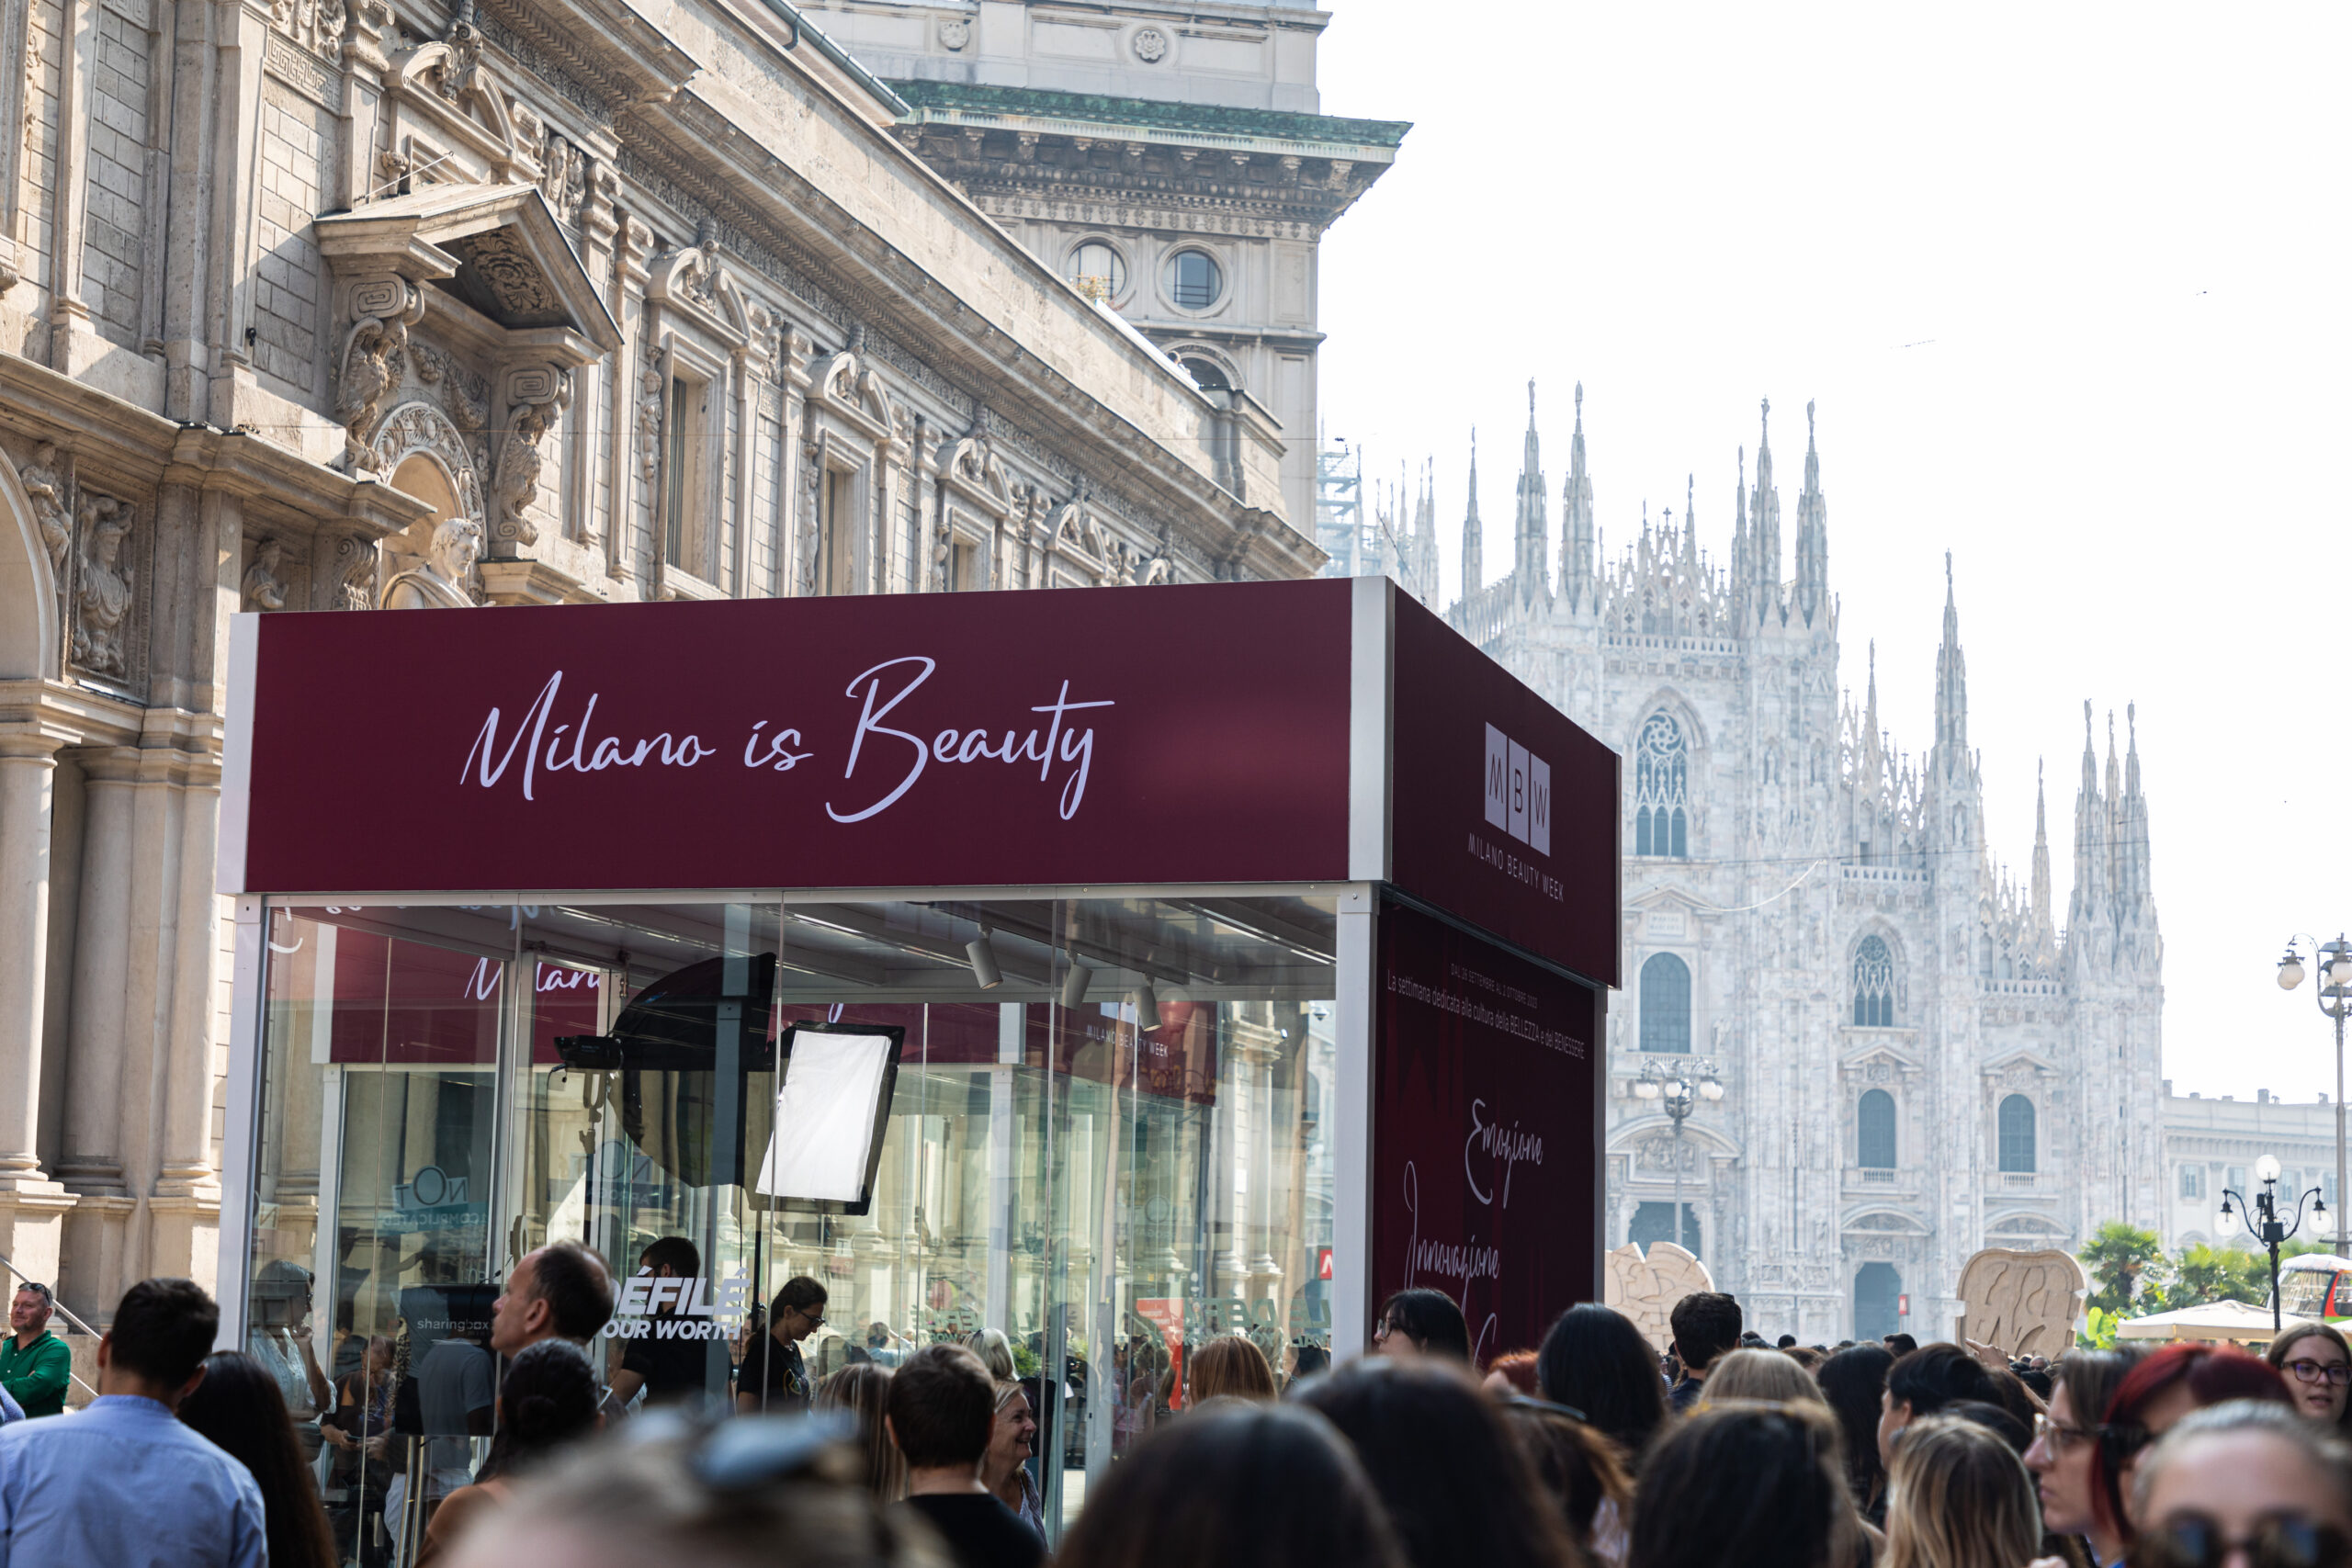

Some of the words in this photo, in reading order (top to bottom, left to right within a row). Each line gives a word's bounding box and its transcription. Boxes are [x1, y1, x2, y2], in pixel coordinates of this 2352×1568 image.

[460, 671, 716, 800] Milano
[745, 721, 813, 771] is
[826, 657, 1114, 823] Beauty
[1468, 831, 1504, 870] MILANO
[1507, 854, 1539, 888] BEAUTY
[1542, 874, 1564, 902] WEEK
[1387, 969, 1396, 992] La
[1397, 976, 1431, 1005] settimana
[1432, 986, 1460, 1015] dedicata
[1461, 996, 1472, 1018] alla
[1474, 1000, 1494, 1026] cultura
[1495, 1009, 1510, 1032] della
[1510, 1014, 1540, 1043] BELLEZZA
[1545, 1029, 1554, 1048] del
[1555, 1031, 1586, 1060] BENESSERE
[1465, 1099, 1544, 1210] Emozione
[602, 1319, 651, 1339] OUR
[656, 1320, 742, 1340] WORTH
